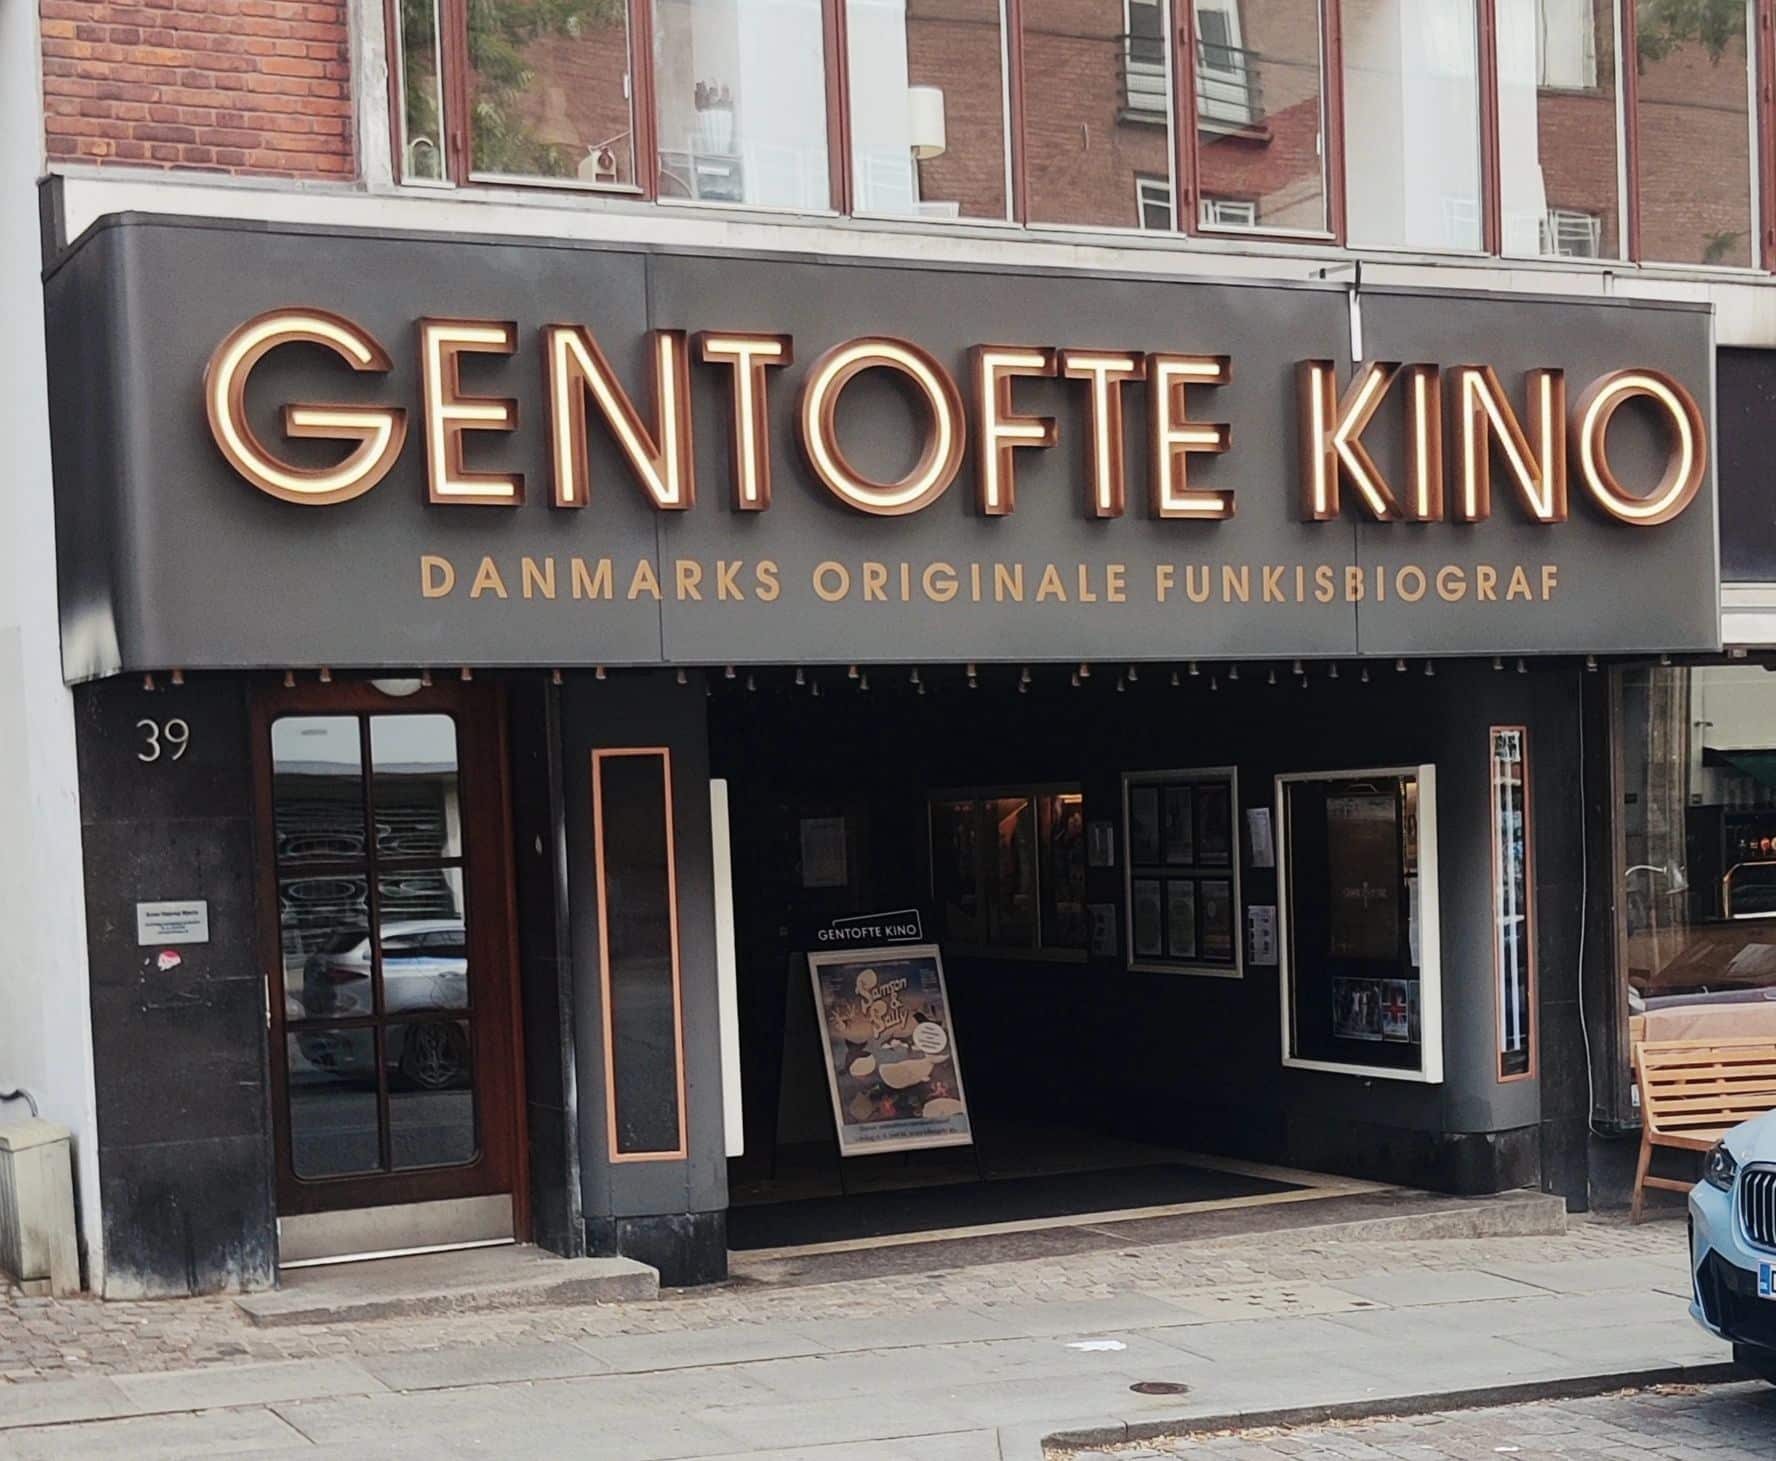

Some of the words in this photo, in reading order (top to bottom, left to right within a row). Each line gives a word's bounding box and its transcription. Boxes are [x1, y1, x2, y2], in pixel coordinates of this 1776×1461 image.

[204, 305, 1236, 520] GENTOFTE
[1295, 358, 1708, 527] KINO
[420, 554, 782, 603] DANMARKS
[812, 559, 1128, 604] ORIGINALE
[1155, 562, 1562, 604] FUNKISBIOGRAF
[136, 719, 190, 762] 39
[817, 926, 882, 942] GENTOFTE
[884, 923, 917, 938] KINO
[855, 968, 907, 1014] Samson
[890, 992, 904, 1009] &
[870, 1000, 910, 1040] Sally
